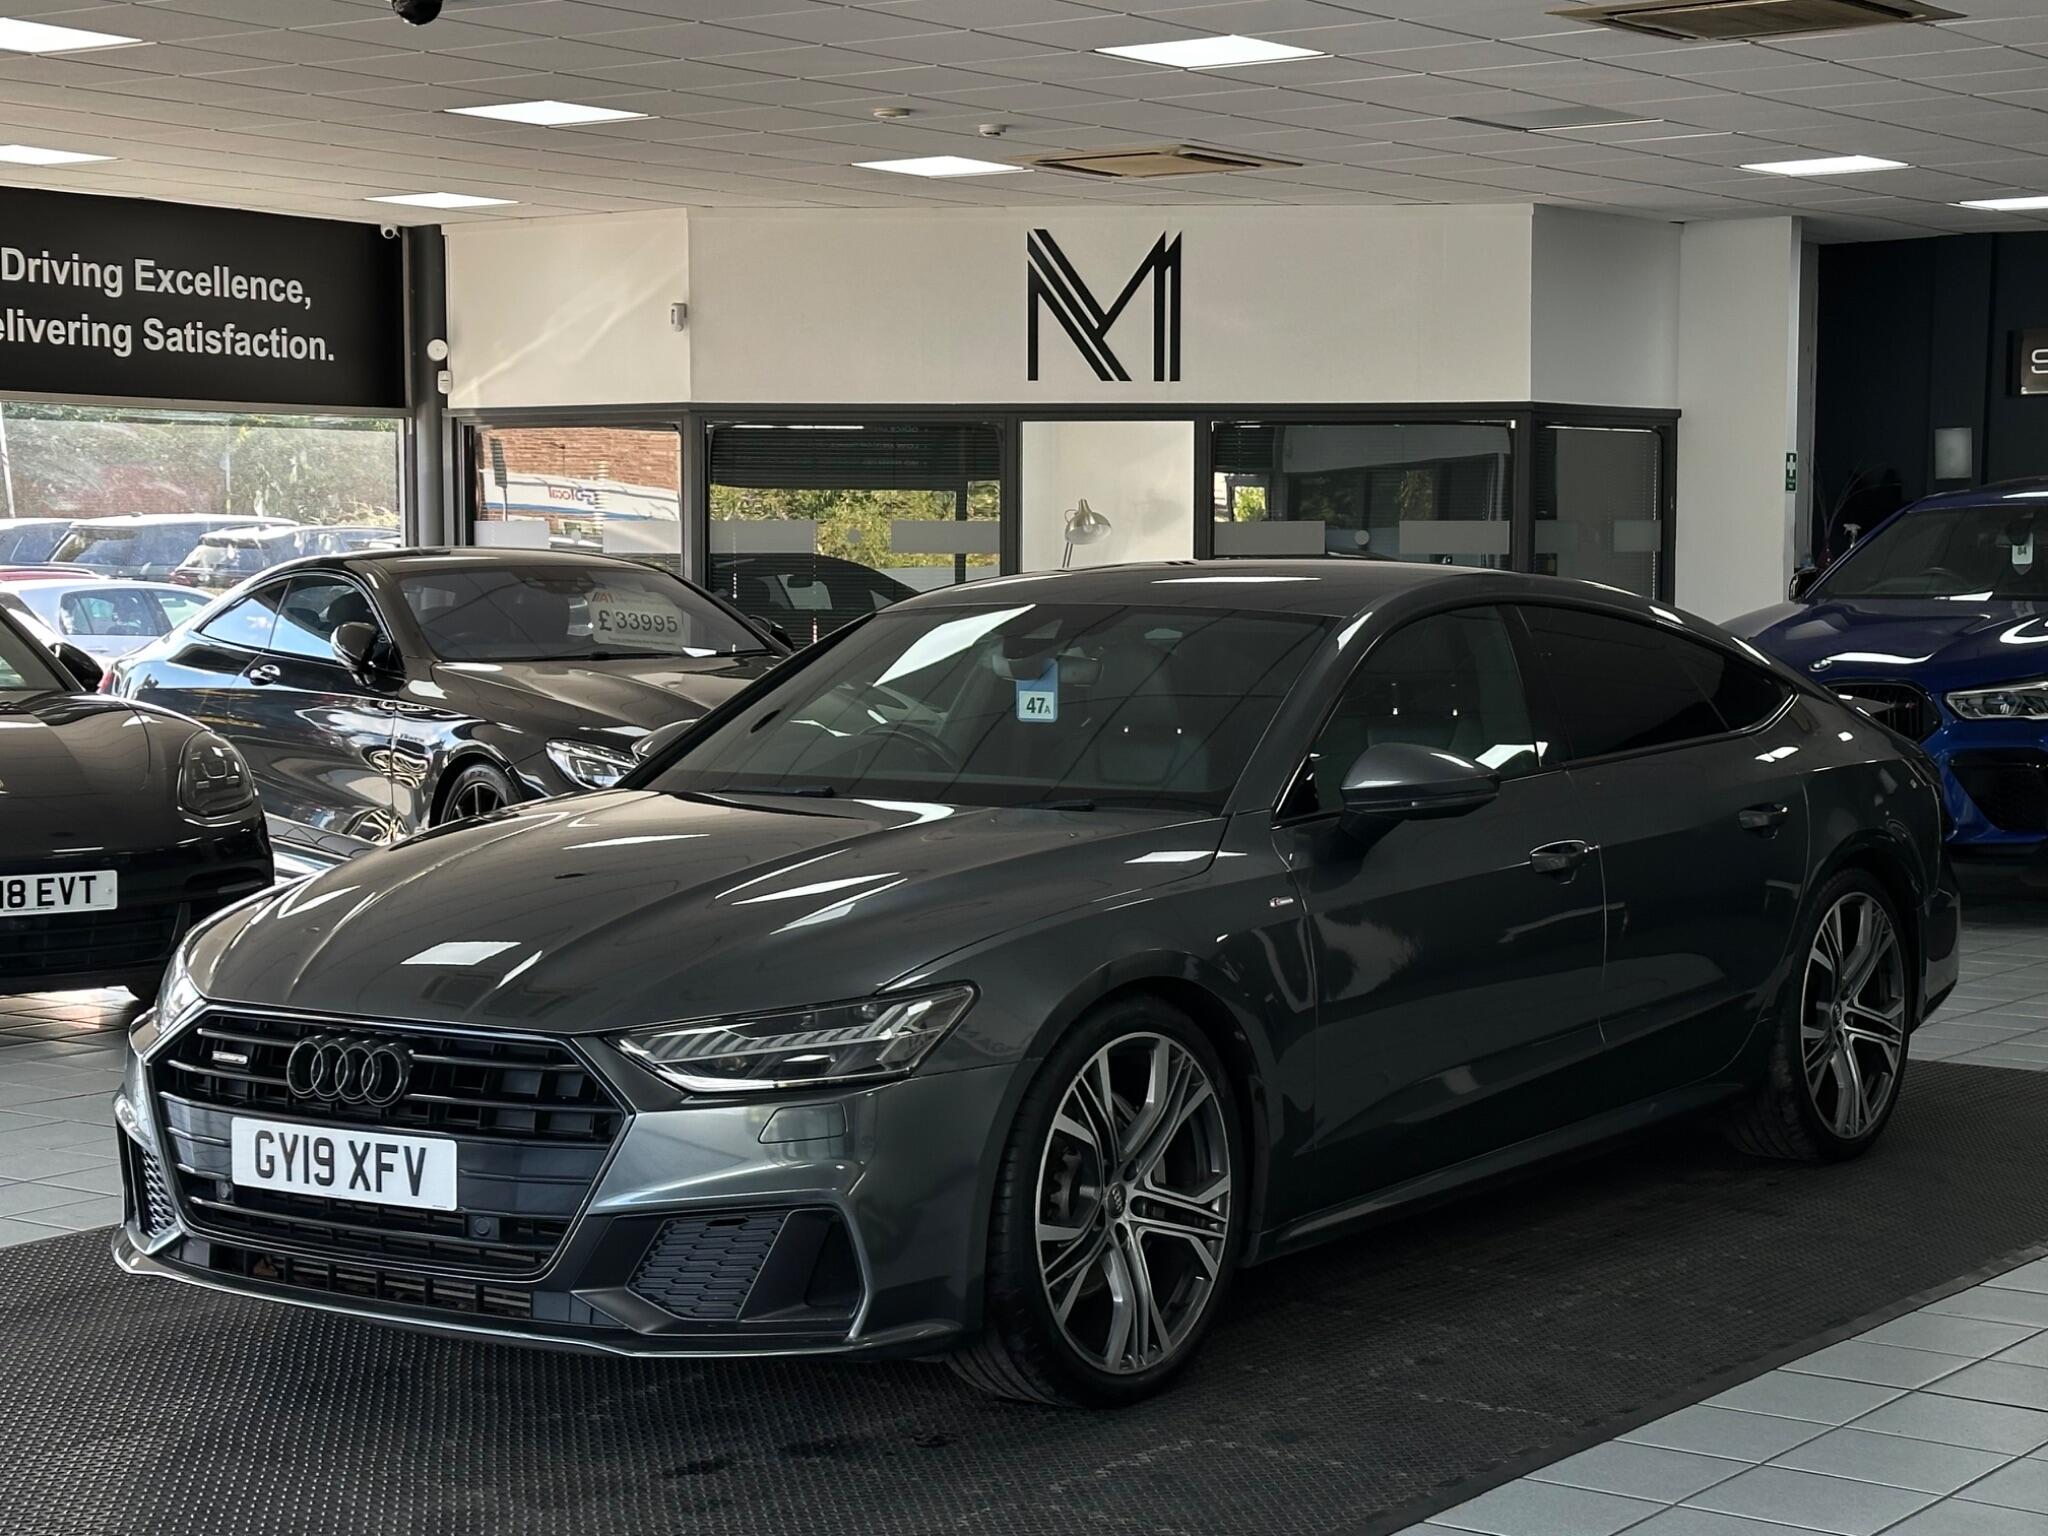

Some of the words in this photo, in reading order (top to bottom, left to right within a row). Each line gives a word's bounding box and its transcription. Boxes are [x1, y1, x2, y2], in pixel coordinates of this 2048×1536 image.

[1, 247, 123, 298] Driving
[134, 258, 312, 309] Excellence,
[143, 317, 335, 361] Satisfaction.
[598, 610, 678, 633] £33995
[37, 875, 97, 907] EVT
[255, 1130, 335, 1187] GY19
[348, 1140, 427, 1197] XFV
